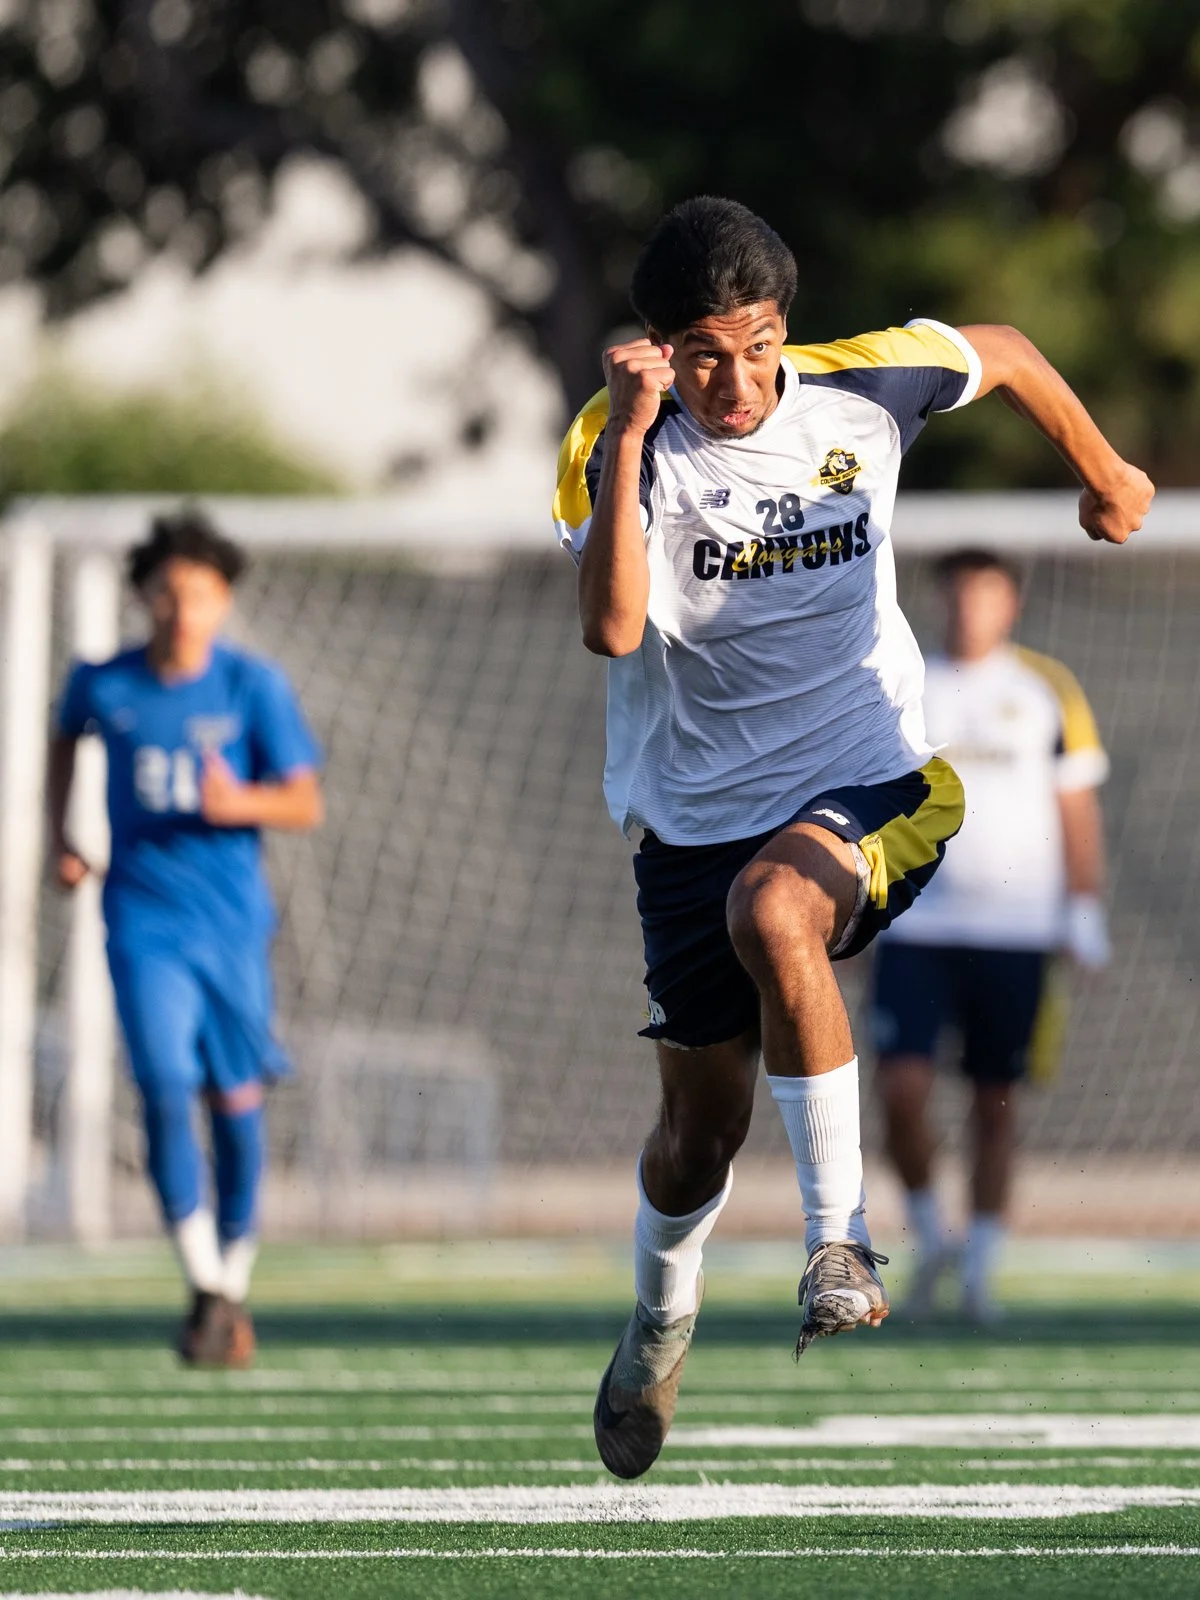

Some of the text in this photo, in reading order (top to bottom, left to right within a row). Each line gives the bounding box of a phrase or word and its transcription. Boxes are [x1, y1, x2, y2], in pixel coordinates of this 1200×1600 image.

[756, 493, 804, 535] 28
[693, 512, 872, 581] CANYONS
[731, 537, 845, 571] Cougars
